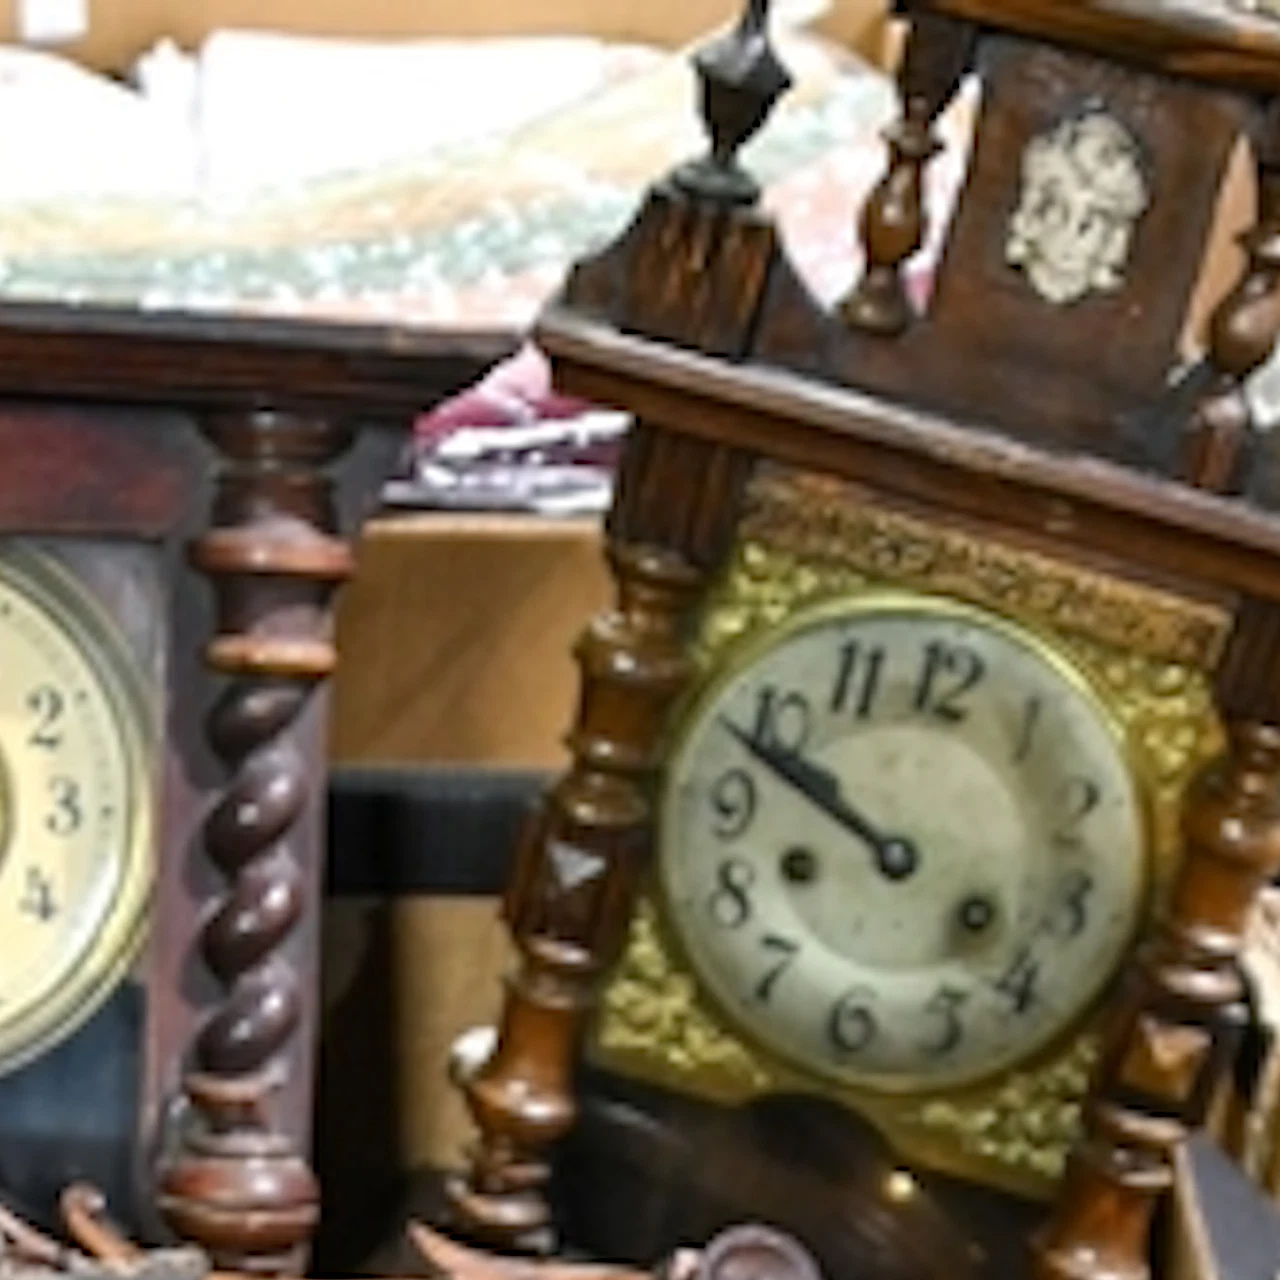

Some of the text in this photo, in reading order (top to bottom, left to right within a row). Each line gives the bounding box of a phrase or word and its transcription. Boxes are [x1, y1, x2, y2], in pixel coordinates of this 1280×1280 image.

[831, 640, 886, 720] 11
[912, 640, 984, 721] 12
[27, 688, 63, 748] 2
[753, 687, 810, 754] 10
[1015, 698, 1040, 760] 1
[48, 778, 82, 834] 3
[710, 771, 758, 839] 9
[1049, 778, 1100, 843] 2
[21, 866, 60, 920] 4
[710, 861, 755, 927] 8
[1046, 875, 1094, 938] 3
[756, 938, 801, 1003] 7
[990, 950, 1037, 1015] 4
[827, 984, 878, 1053] 6
[923, 986, 969, 1053] 5
